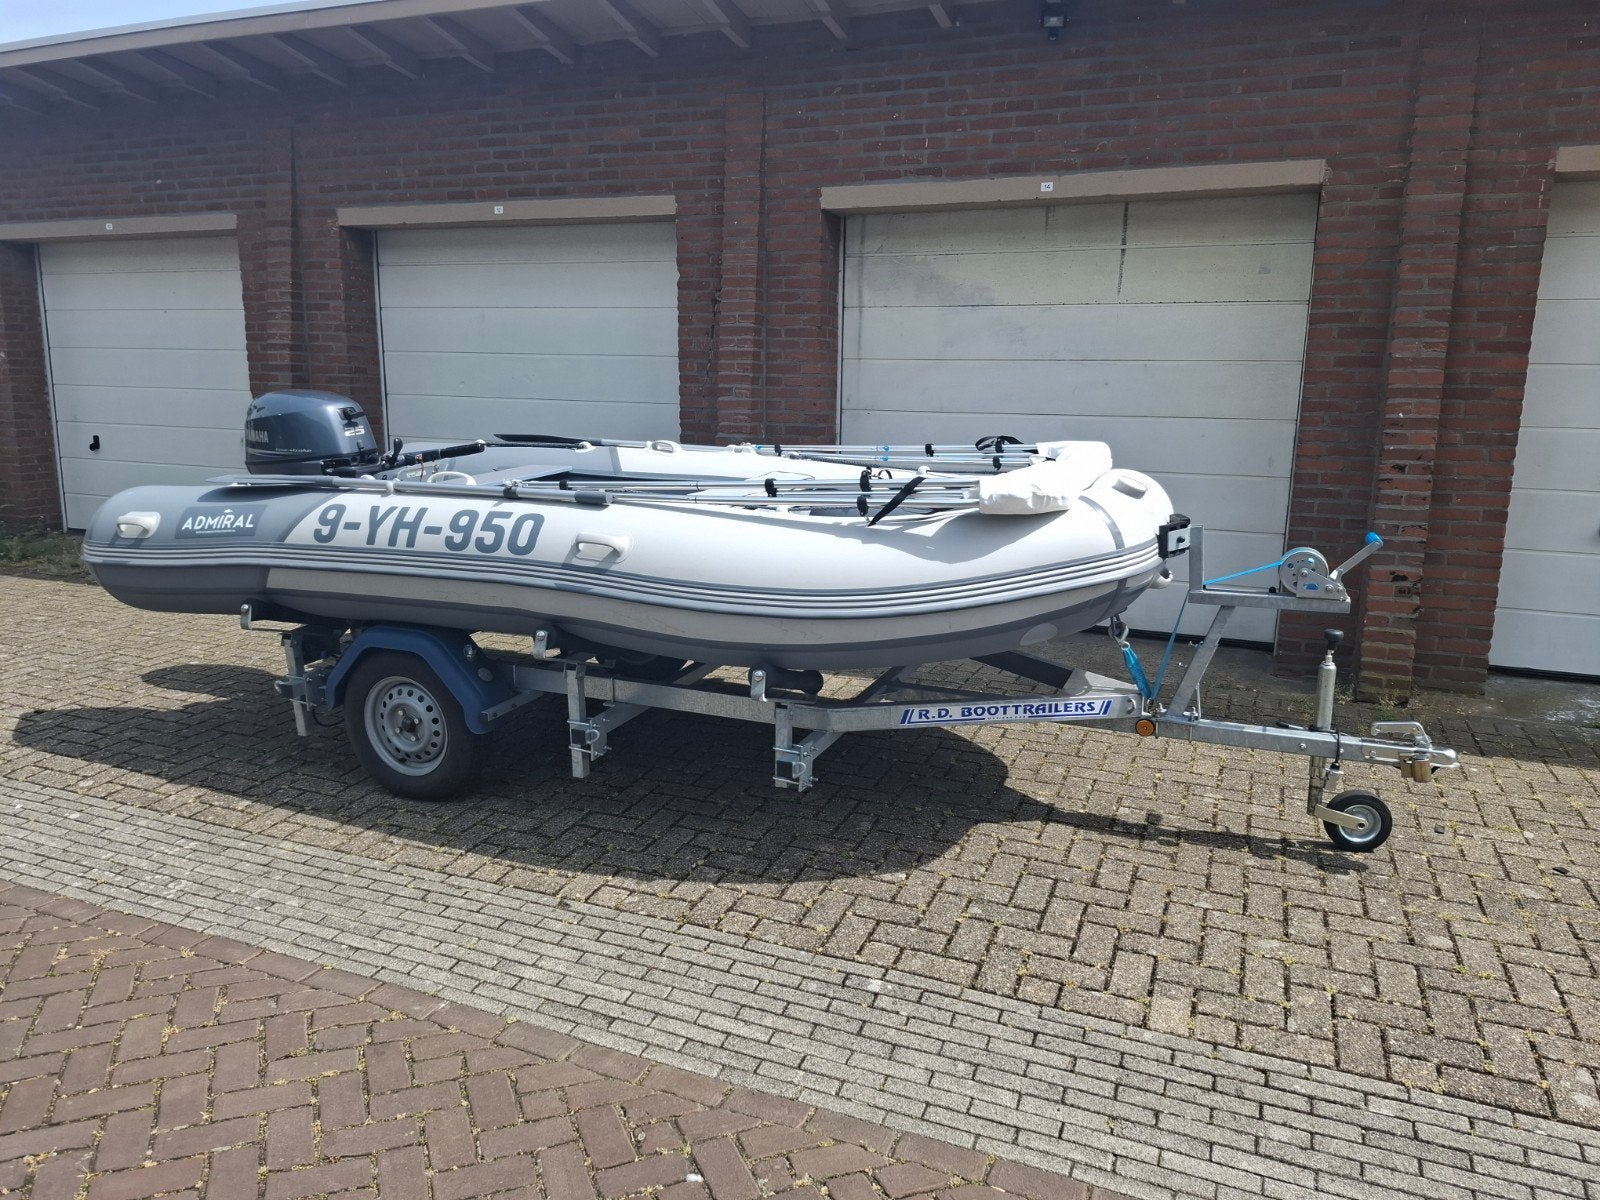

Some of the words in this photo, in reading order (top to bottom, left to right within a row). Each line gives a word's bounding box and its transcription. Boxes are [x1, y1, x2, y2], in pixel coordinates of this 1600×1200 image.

[344, 426, 365, 437] 25
[181, 513, 255, 531] ADMIRAL
[313, 503, 545, 556] 9-YH-950
[918, 707, 953, 720] R.D.
[961, 701, 1096, 718] BOOTTRAILERS
